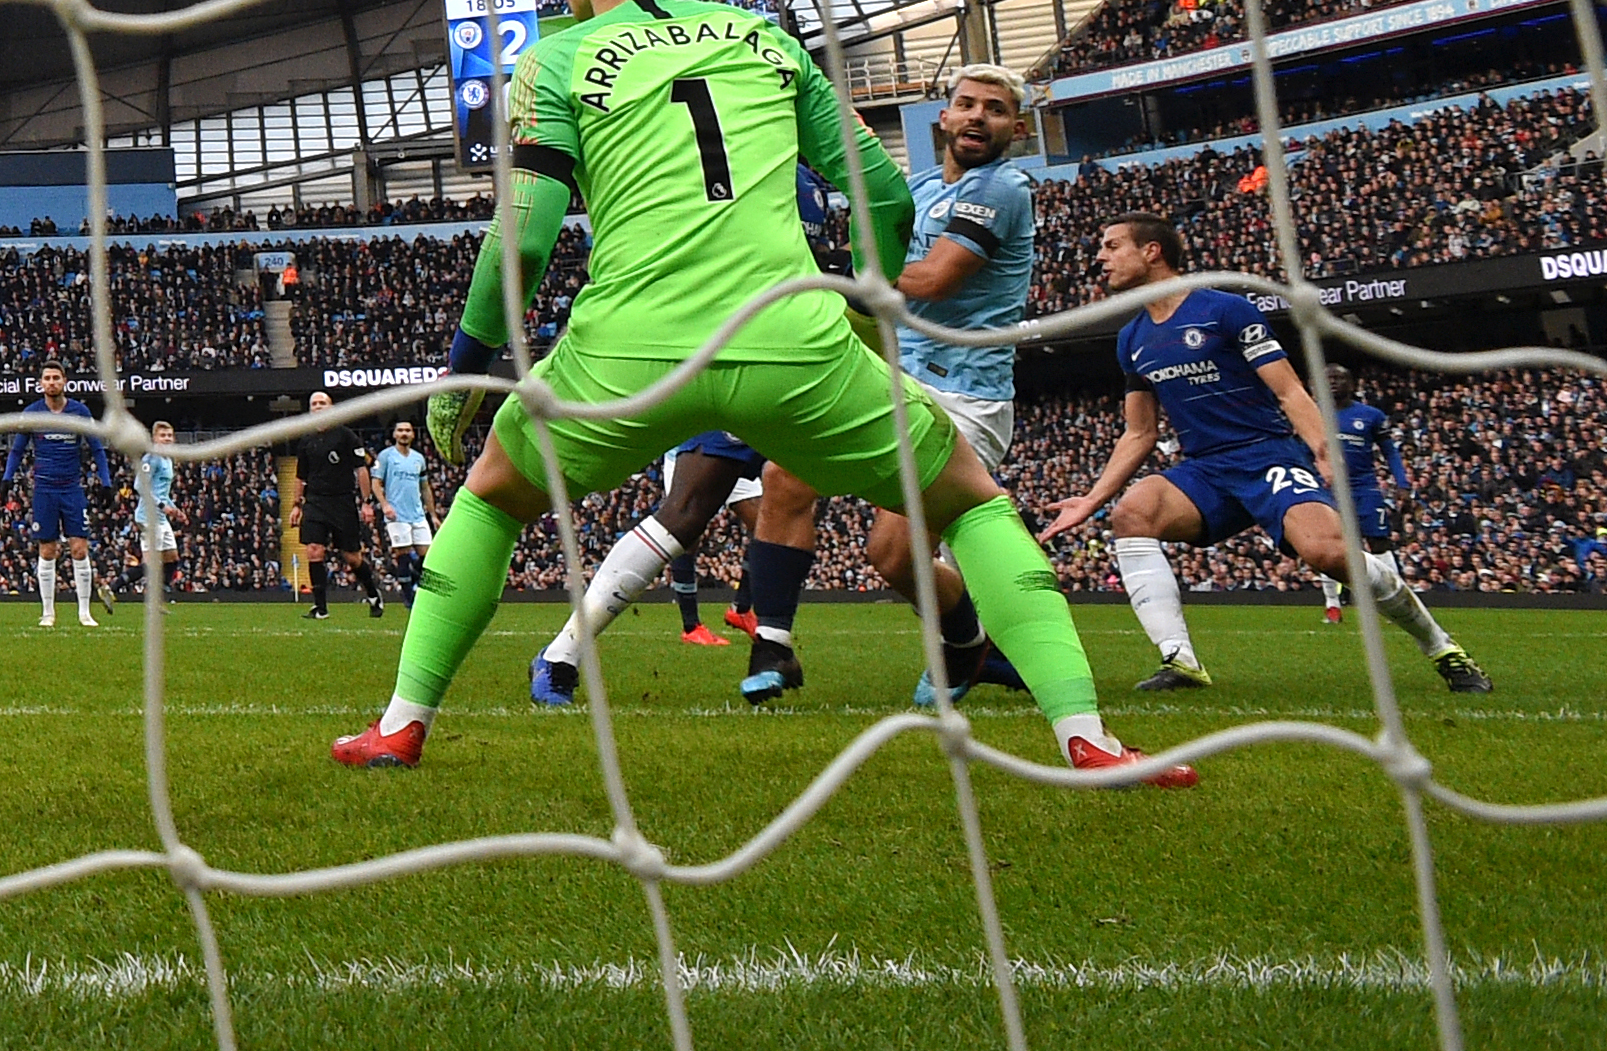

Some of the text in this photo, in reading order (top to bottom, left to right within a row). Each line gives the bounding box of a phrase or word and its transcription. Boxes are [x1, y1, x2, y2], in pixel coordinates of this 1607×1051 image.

[1333, 17, 1384, 42] SUPPORT
[1388, 10, 1423, 33] SINCE
[498, 20, 527, 65] 2
[580, 22, 795, 113] ARRIZABALAGA
[1112, 51, 1234, 87] MADE IN MANCHESTER
[671, 78, 734, 202] 1
[1539, 249, 1607, 281] DSQU
[1345, 278, 1407, 302] Partner
[130, 374, 191, 392] Partner
[1145, 359, 1218, 384] YOKOHAMA
[1265, 466, 1320, 495] 28
[1375, 507, 1386, 525] 7
